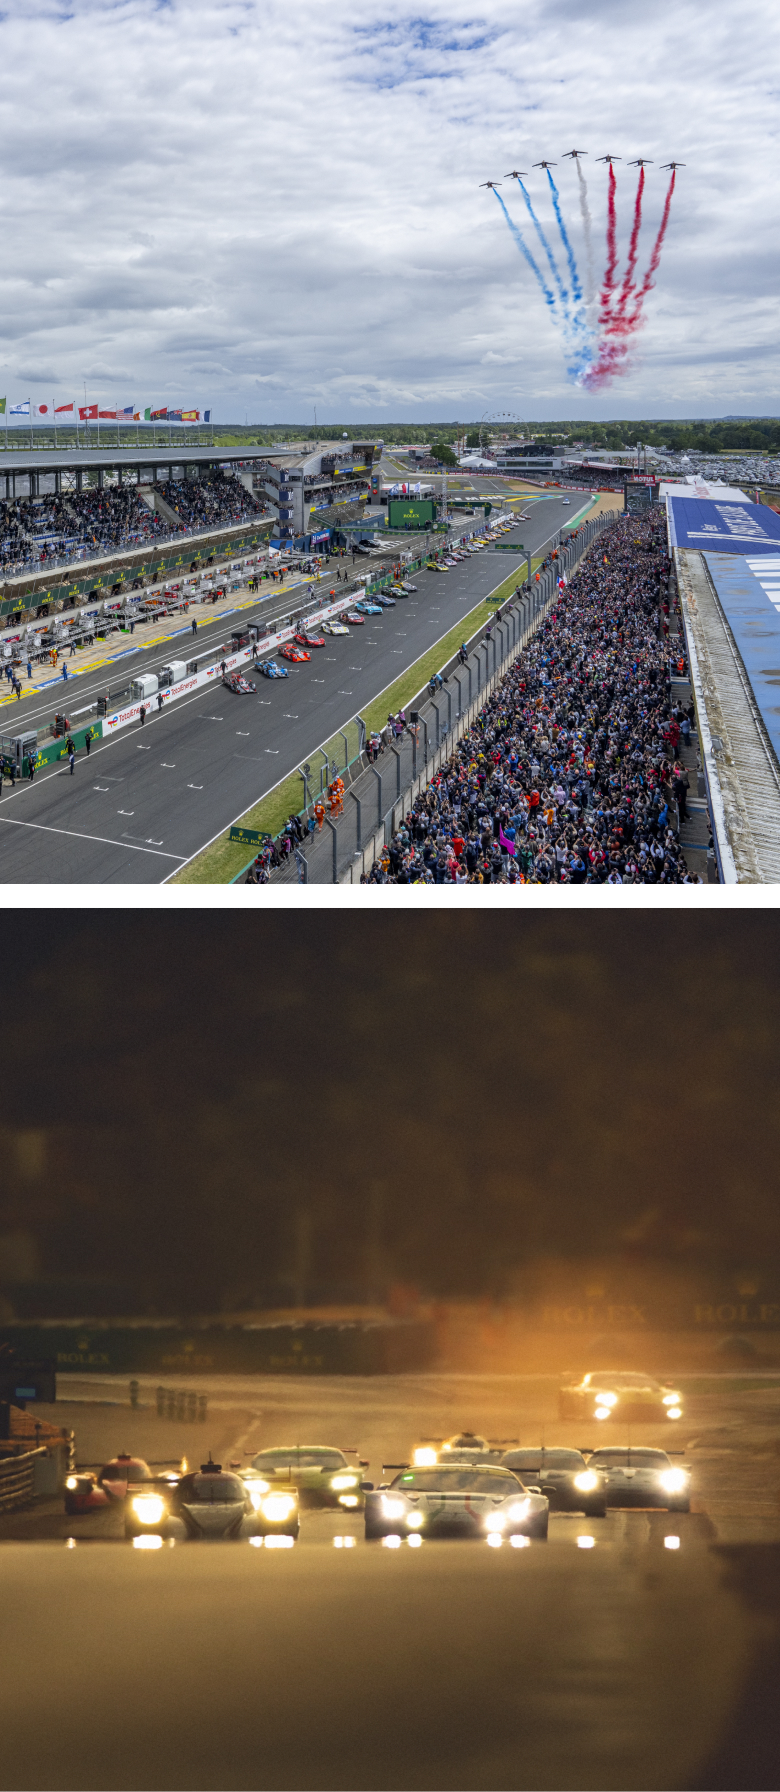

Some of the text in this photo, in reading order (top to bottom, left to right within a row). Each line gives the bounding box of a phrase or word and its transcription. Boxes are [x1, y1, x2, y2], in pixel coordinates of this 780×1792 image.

[171, 678, 198, 696] TotalEnergies
[119, 702, 151, 722] TotalEneies
[544, 1304, 647, 1323] ROLEX
[57, 1353, 110, 1365] ROLEX
